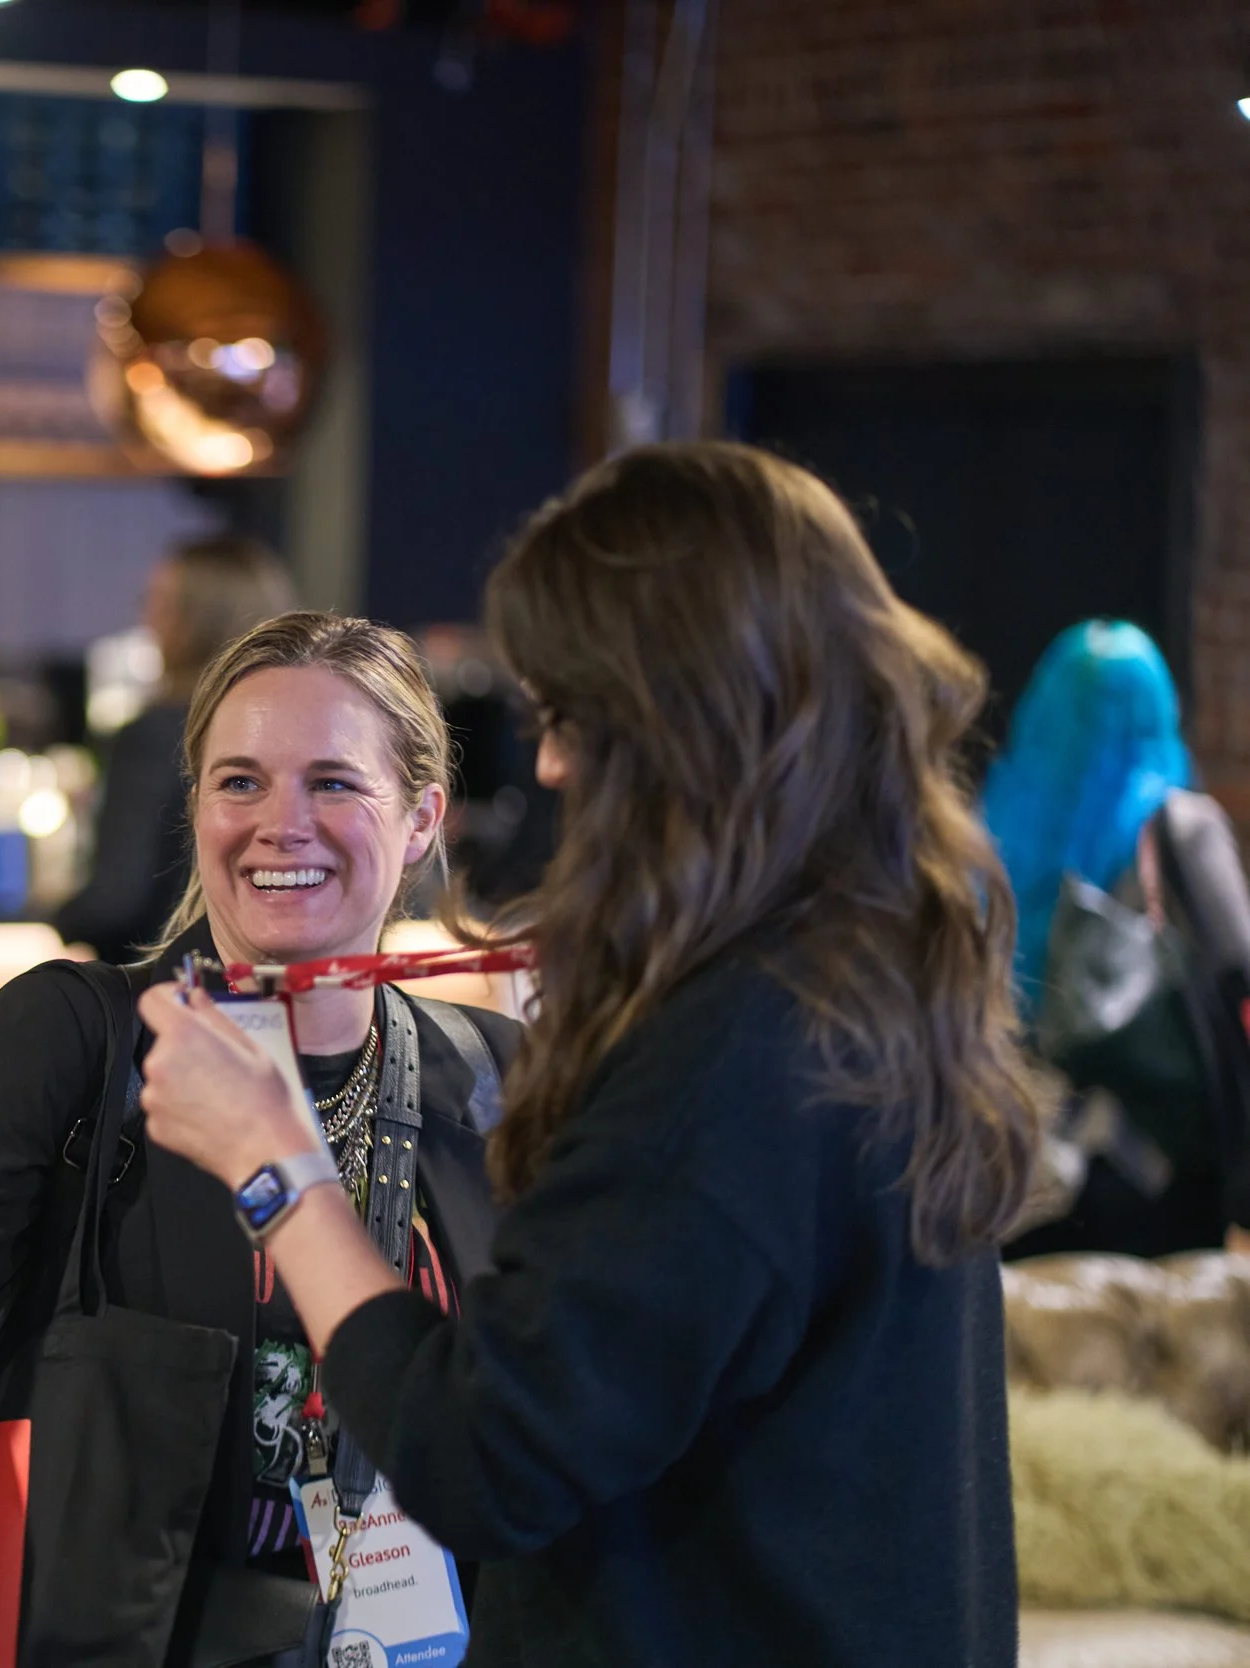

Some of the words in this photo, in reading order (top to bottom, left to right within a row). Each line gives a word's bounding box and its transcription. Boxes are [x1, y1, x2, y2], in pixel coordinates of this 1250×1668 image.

[348, 1544, 411, 1569] Gleason
[353, 1575, 418, 1599] broadhead.
[395, 1645, 446, 1667] Attendee
